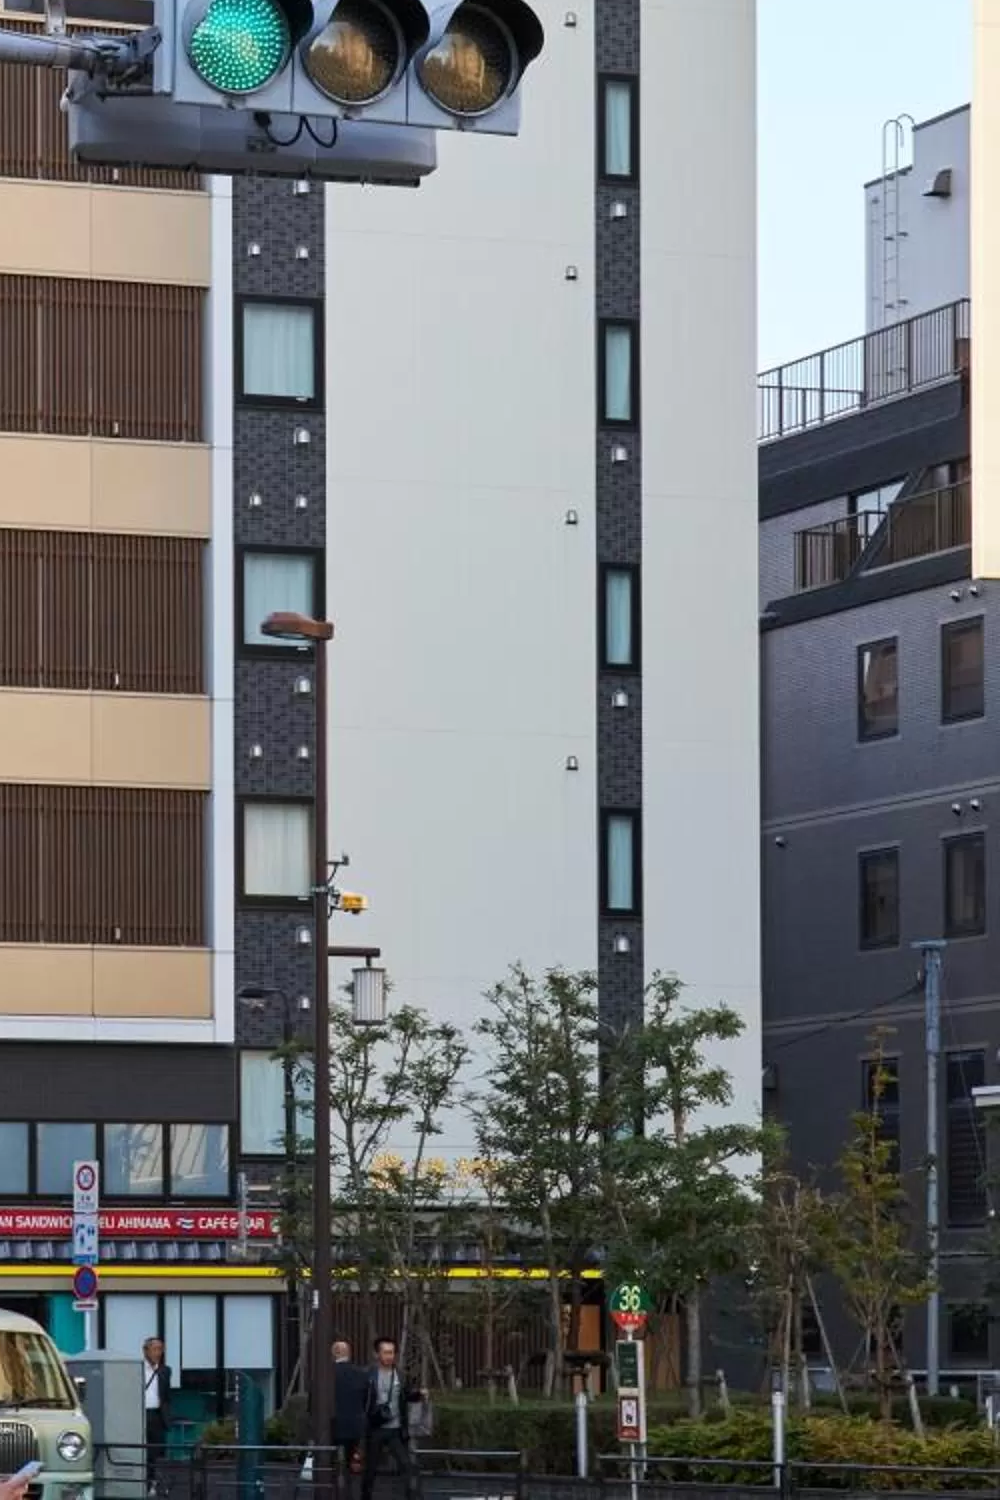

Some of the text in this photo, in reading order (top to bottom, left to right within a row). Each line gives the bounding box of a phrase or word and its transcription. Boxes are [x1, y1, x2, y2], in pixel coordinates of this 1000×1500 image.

[15, 1215, 73, 1230] SANDWIC
[117, 1217, 171, 1229] AHINAMA
[198, 1214, 228, 1229] CAFÉ
[619, 1285, 642, 1311] 36
